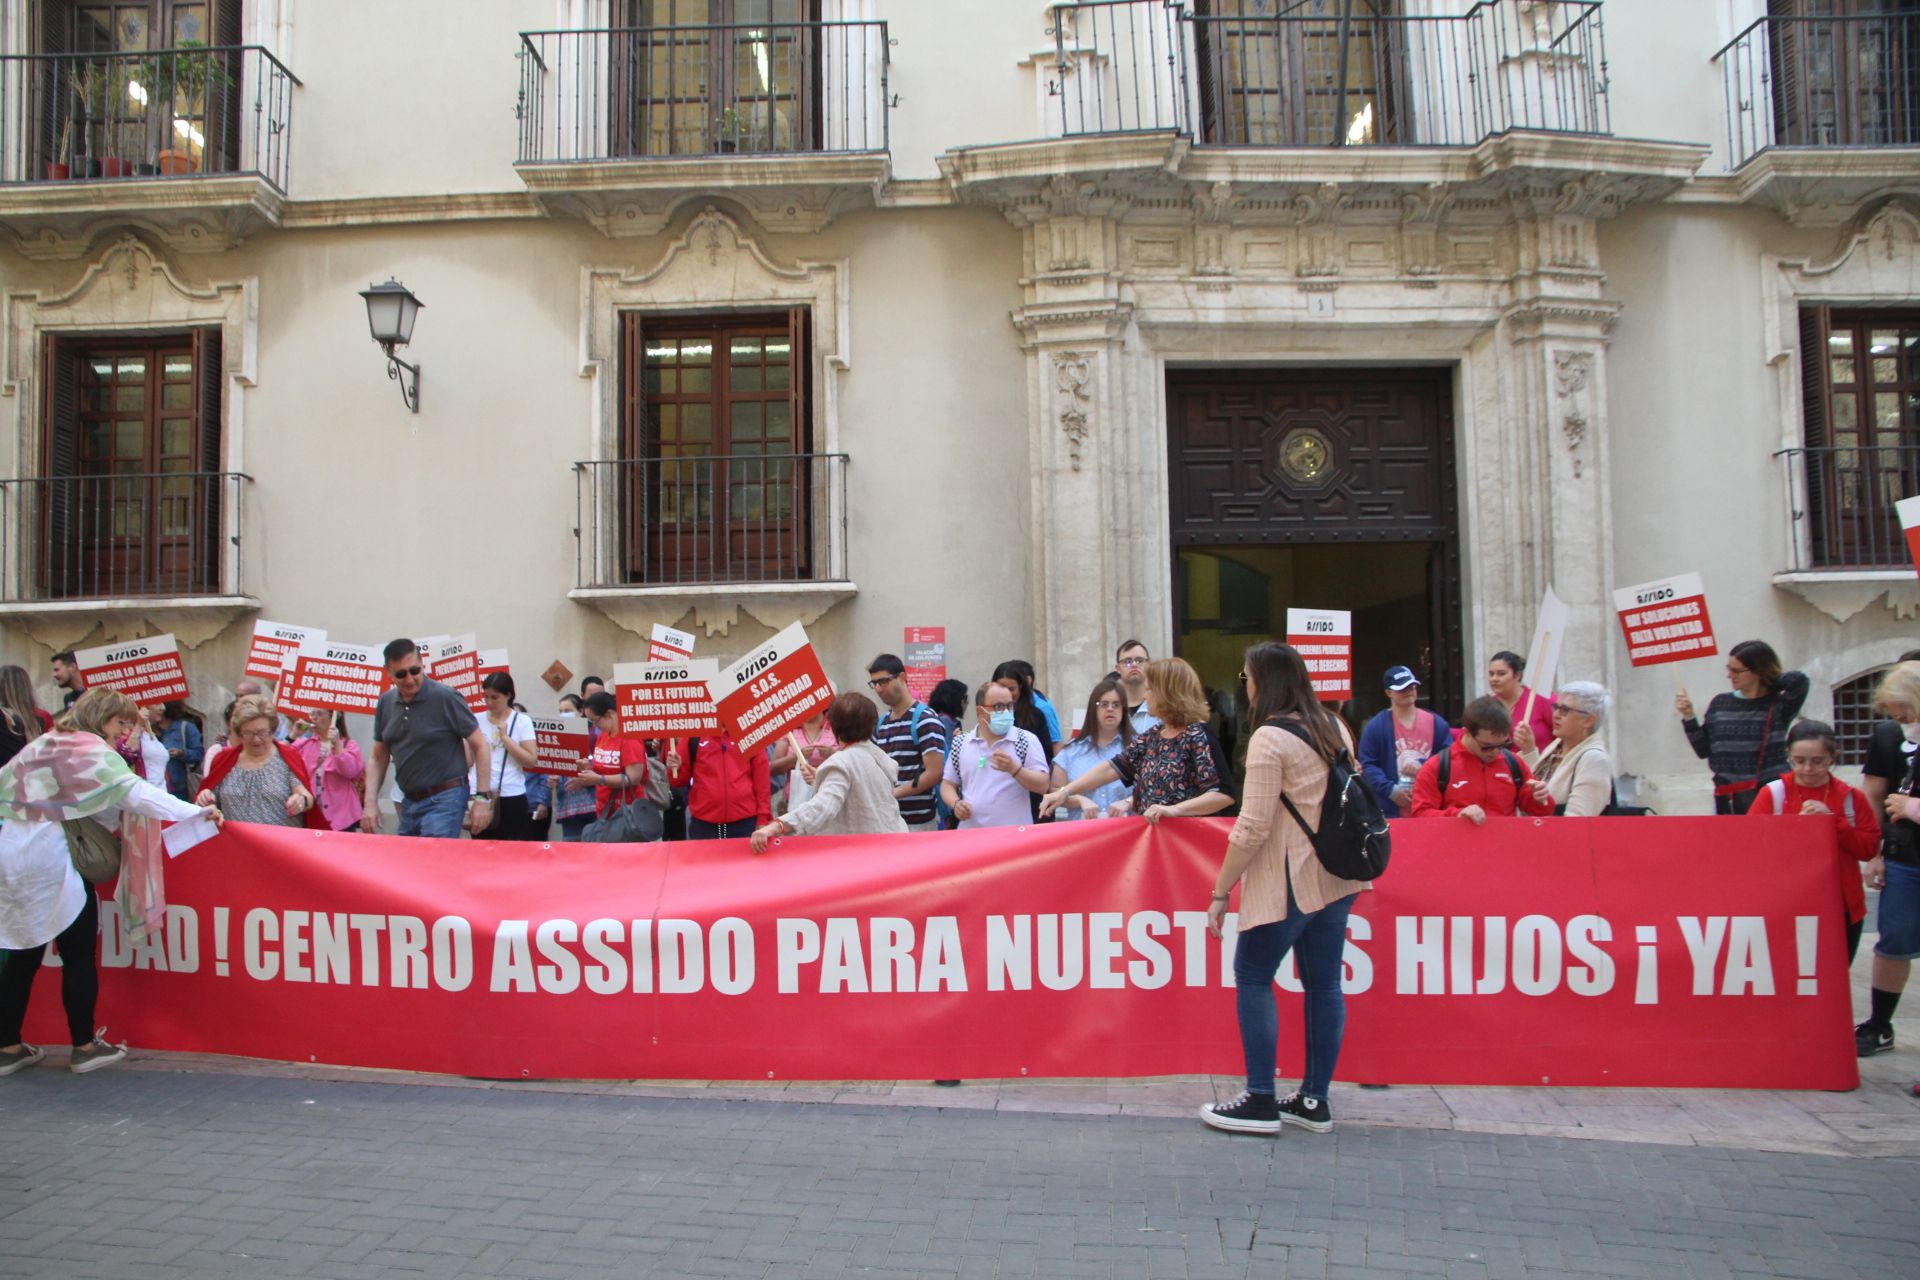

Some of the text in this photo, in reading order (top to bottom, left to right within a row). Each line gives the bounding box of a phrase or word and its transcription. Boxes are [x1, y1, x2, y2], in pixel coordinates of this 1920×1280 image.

[1641, 601, 1700, 625] SOLUCIONES
[1652, 620, 1704, 641] VOLUNTAD
[86, 658, 177, 685] MURCIA LO NECESITA
[127, 676, 149, 688] HIJOS
[149, 669, 182, 682] TAMBIÉN
[305, 661, 383, 682] PREVENCIÓN NO
[142, 686, 173, 699] ASSIDO
[172, 683, 187, 693] YA!
[301, 676, 315, 687] ES
[315, 676, 381, 697] PROHIBICIÓN
[632, 686, 704, 701] POR EL FUTURO
[750, 672, 781, 698] S.O.S.
[294, 689, 336, 703] ¡CAMPUS
[335, 693, 368, 708] ASSIDO
[621, 701, 717, 717] DE NUESTROS HIJOS
[737, 673, 813, 731] DISCAPACIDAD
[623, 717, 717, 733] ¡CAMPUS ASSIDO YA!
[738, 685, 831, 753] ¡RESIDENCIA ASSIDO YA!
[538, 734, 560, 745] S.O.S.
[537, 746, 580, 760] CAPACIDAD
[243, 907, 473, 992] CENTRO
[490, 916, 755, 996] ASSIDO
[776, 916, 968, 994] PARA
[986, 910, 1374, 995] NUESTS
[1395, 914, 1616, 996] HIJOS
